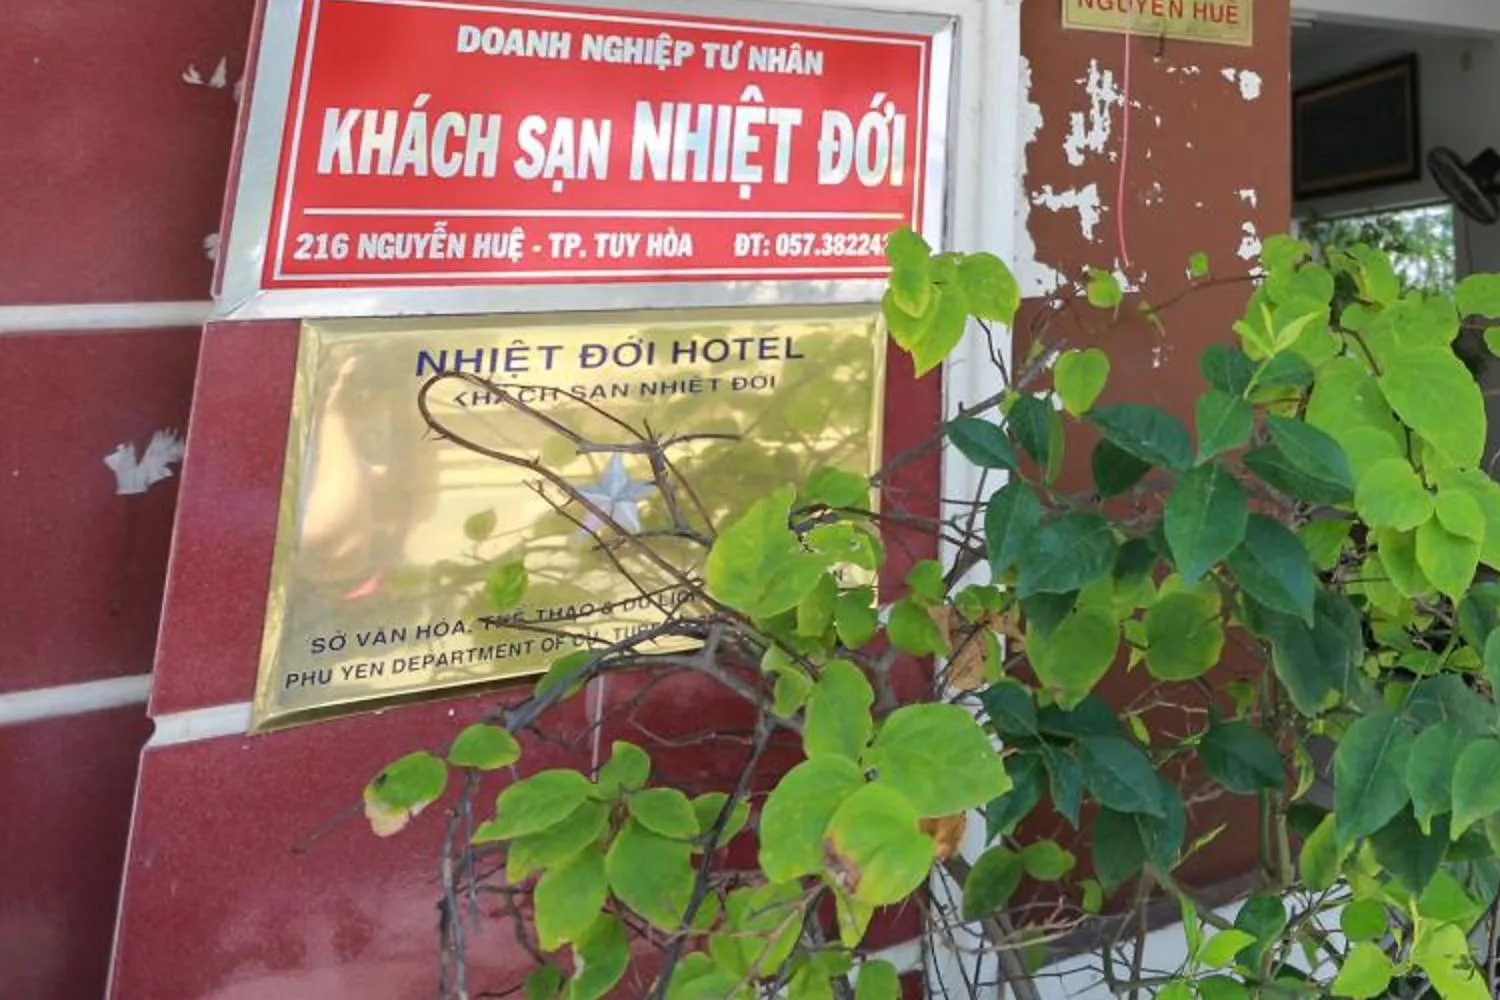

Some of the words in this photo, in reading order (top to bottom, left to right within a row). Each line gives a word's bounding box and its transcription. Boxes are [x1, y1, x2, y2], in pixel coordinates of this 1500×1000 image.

[457, 25, 571, 59] DOANH
[581, 33, 694, 69] NGHIỆP
[702, 40, 743, 70] TƯ
[748, 42, 823, 76] NHÂN
[317, 93, 502, 179] KHÁCH
[513, 117, 611, 194] SẠN
[629, 85, 801, 200] NHIỆT
[816, 92, 908, 187] ĐỚI
[293, 233, 350, 260] 216
[357, 221, 466, 260] NGUYỄN
[472, 226, 526, 263] HUỆ
[549, 233, 587, 258] TP.
[594, 233, 641, 258] TUY
[646, 226, 693, 258] HÒA
[733, 233, 771, 257] ĐT:
[415, 339, 564, 378] NHIỆT
[579, 335, 655, 369] ĐỚI
[671, 336, 805, 364] HOTEL
[341, 661, 384, 681] YEN
[392, 639, 535, 676] DEPARTMENT
[541, 635, 565, 652] OF
